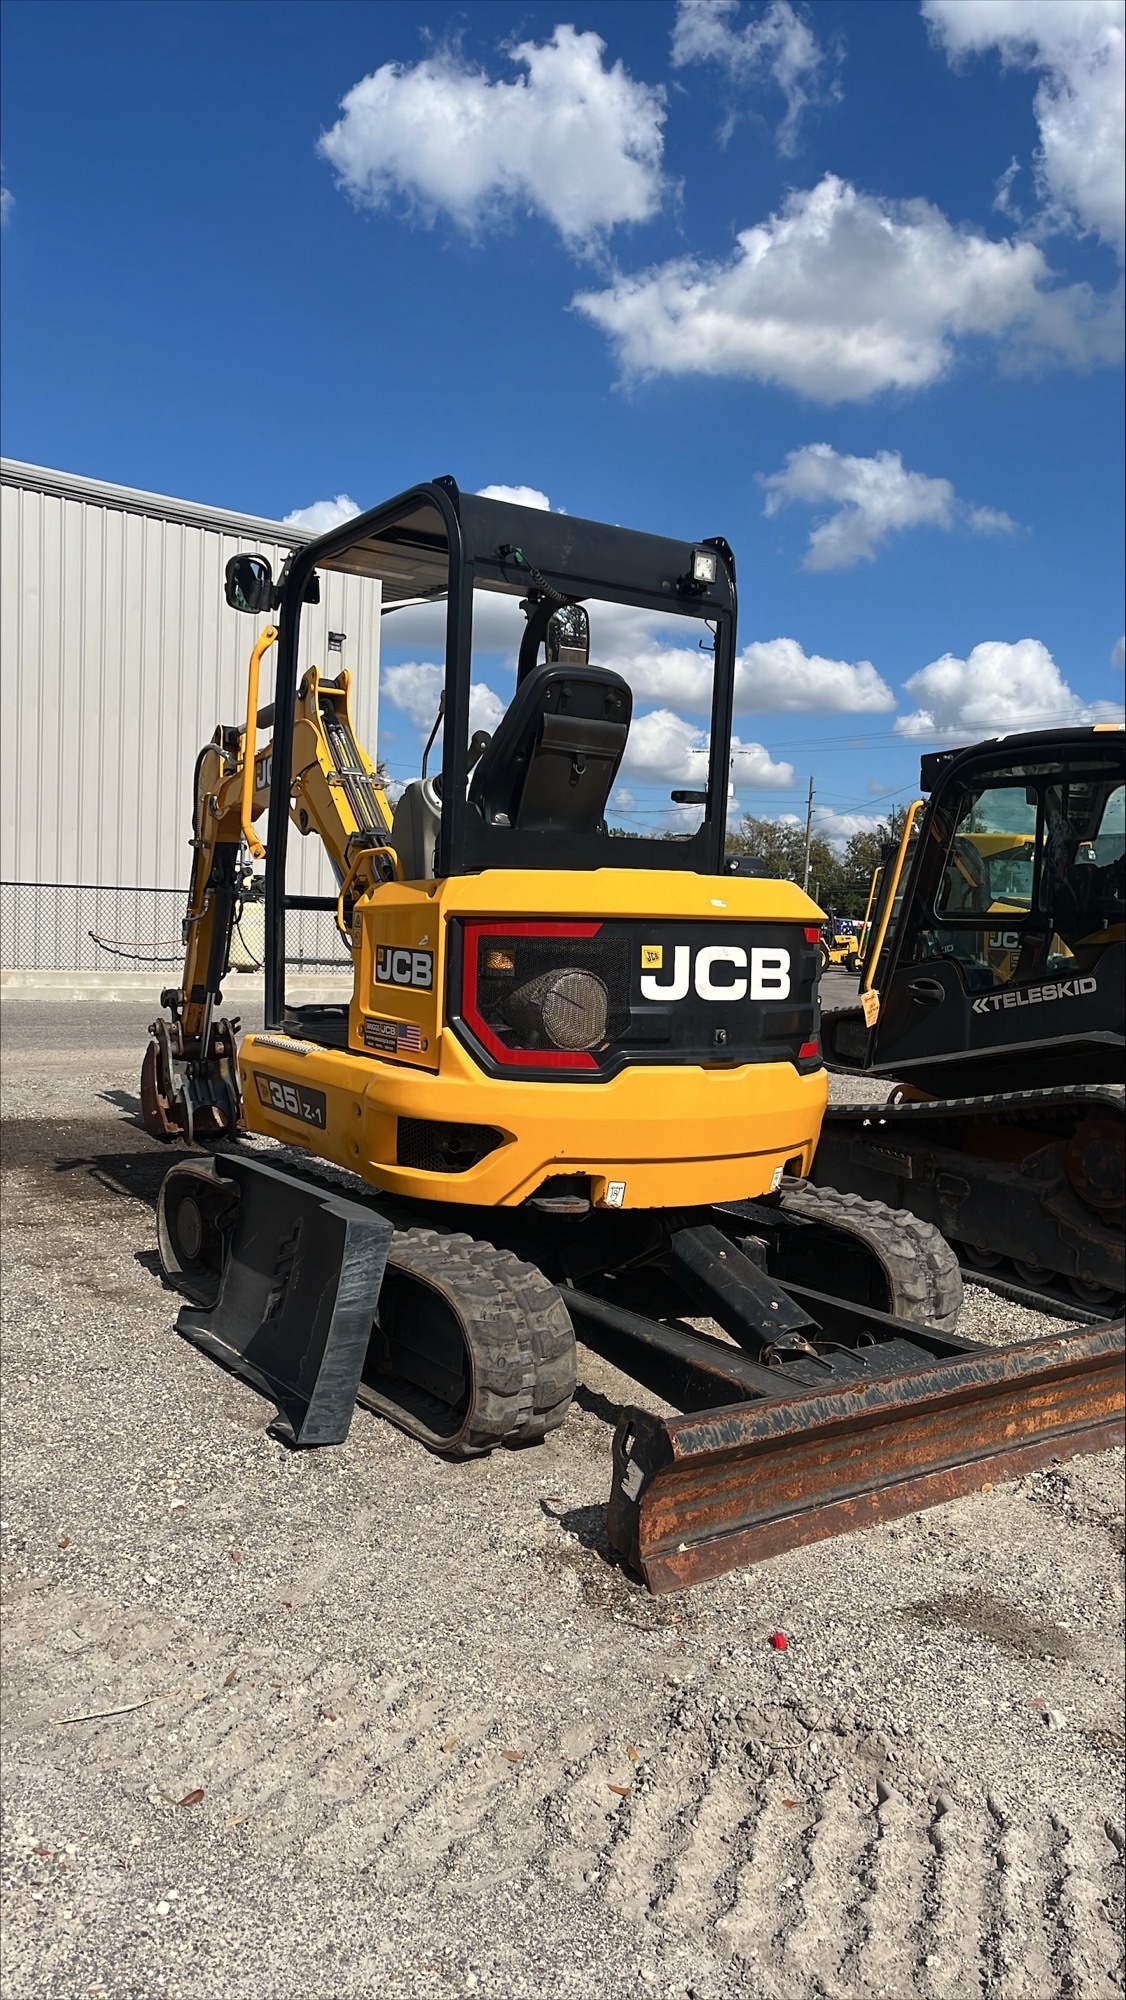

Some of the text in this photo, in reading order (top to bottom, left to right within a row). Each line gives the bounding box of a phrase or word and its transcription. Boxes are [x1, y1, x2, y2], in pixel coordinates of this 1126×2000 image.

[377, 949, 431, 986] JCB
[640, 945, 791, 1001] JCB
[989, 977, 1097, 1010] TELESKID
[381, 1024, 396, 1035] JCB
[269, 1081, 299, 1114] 35
